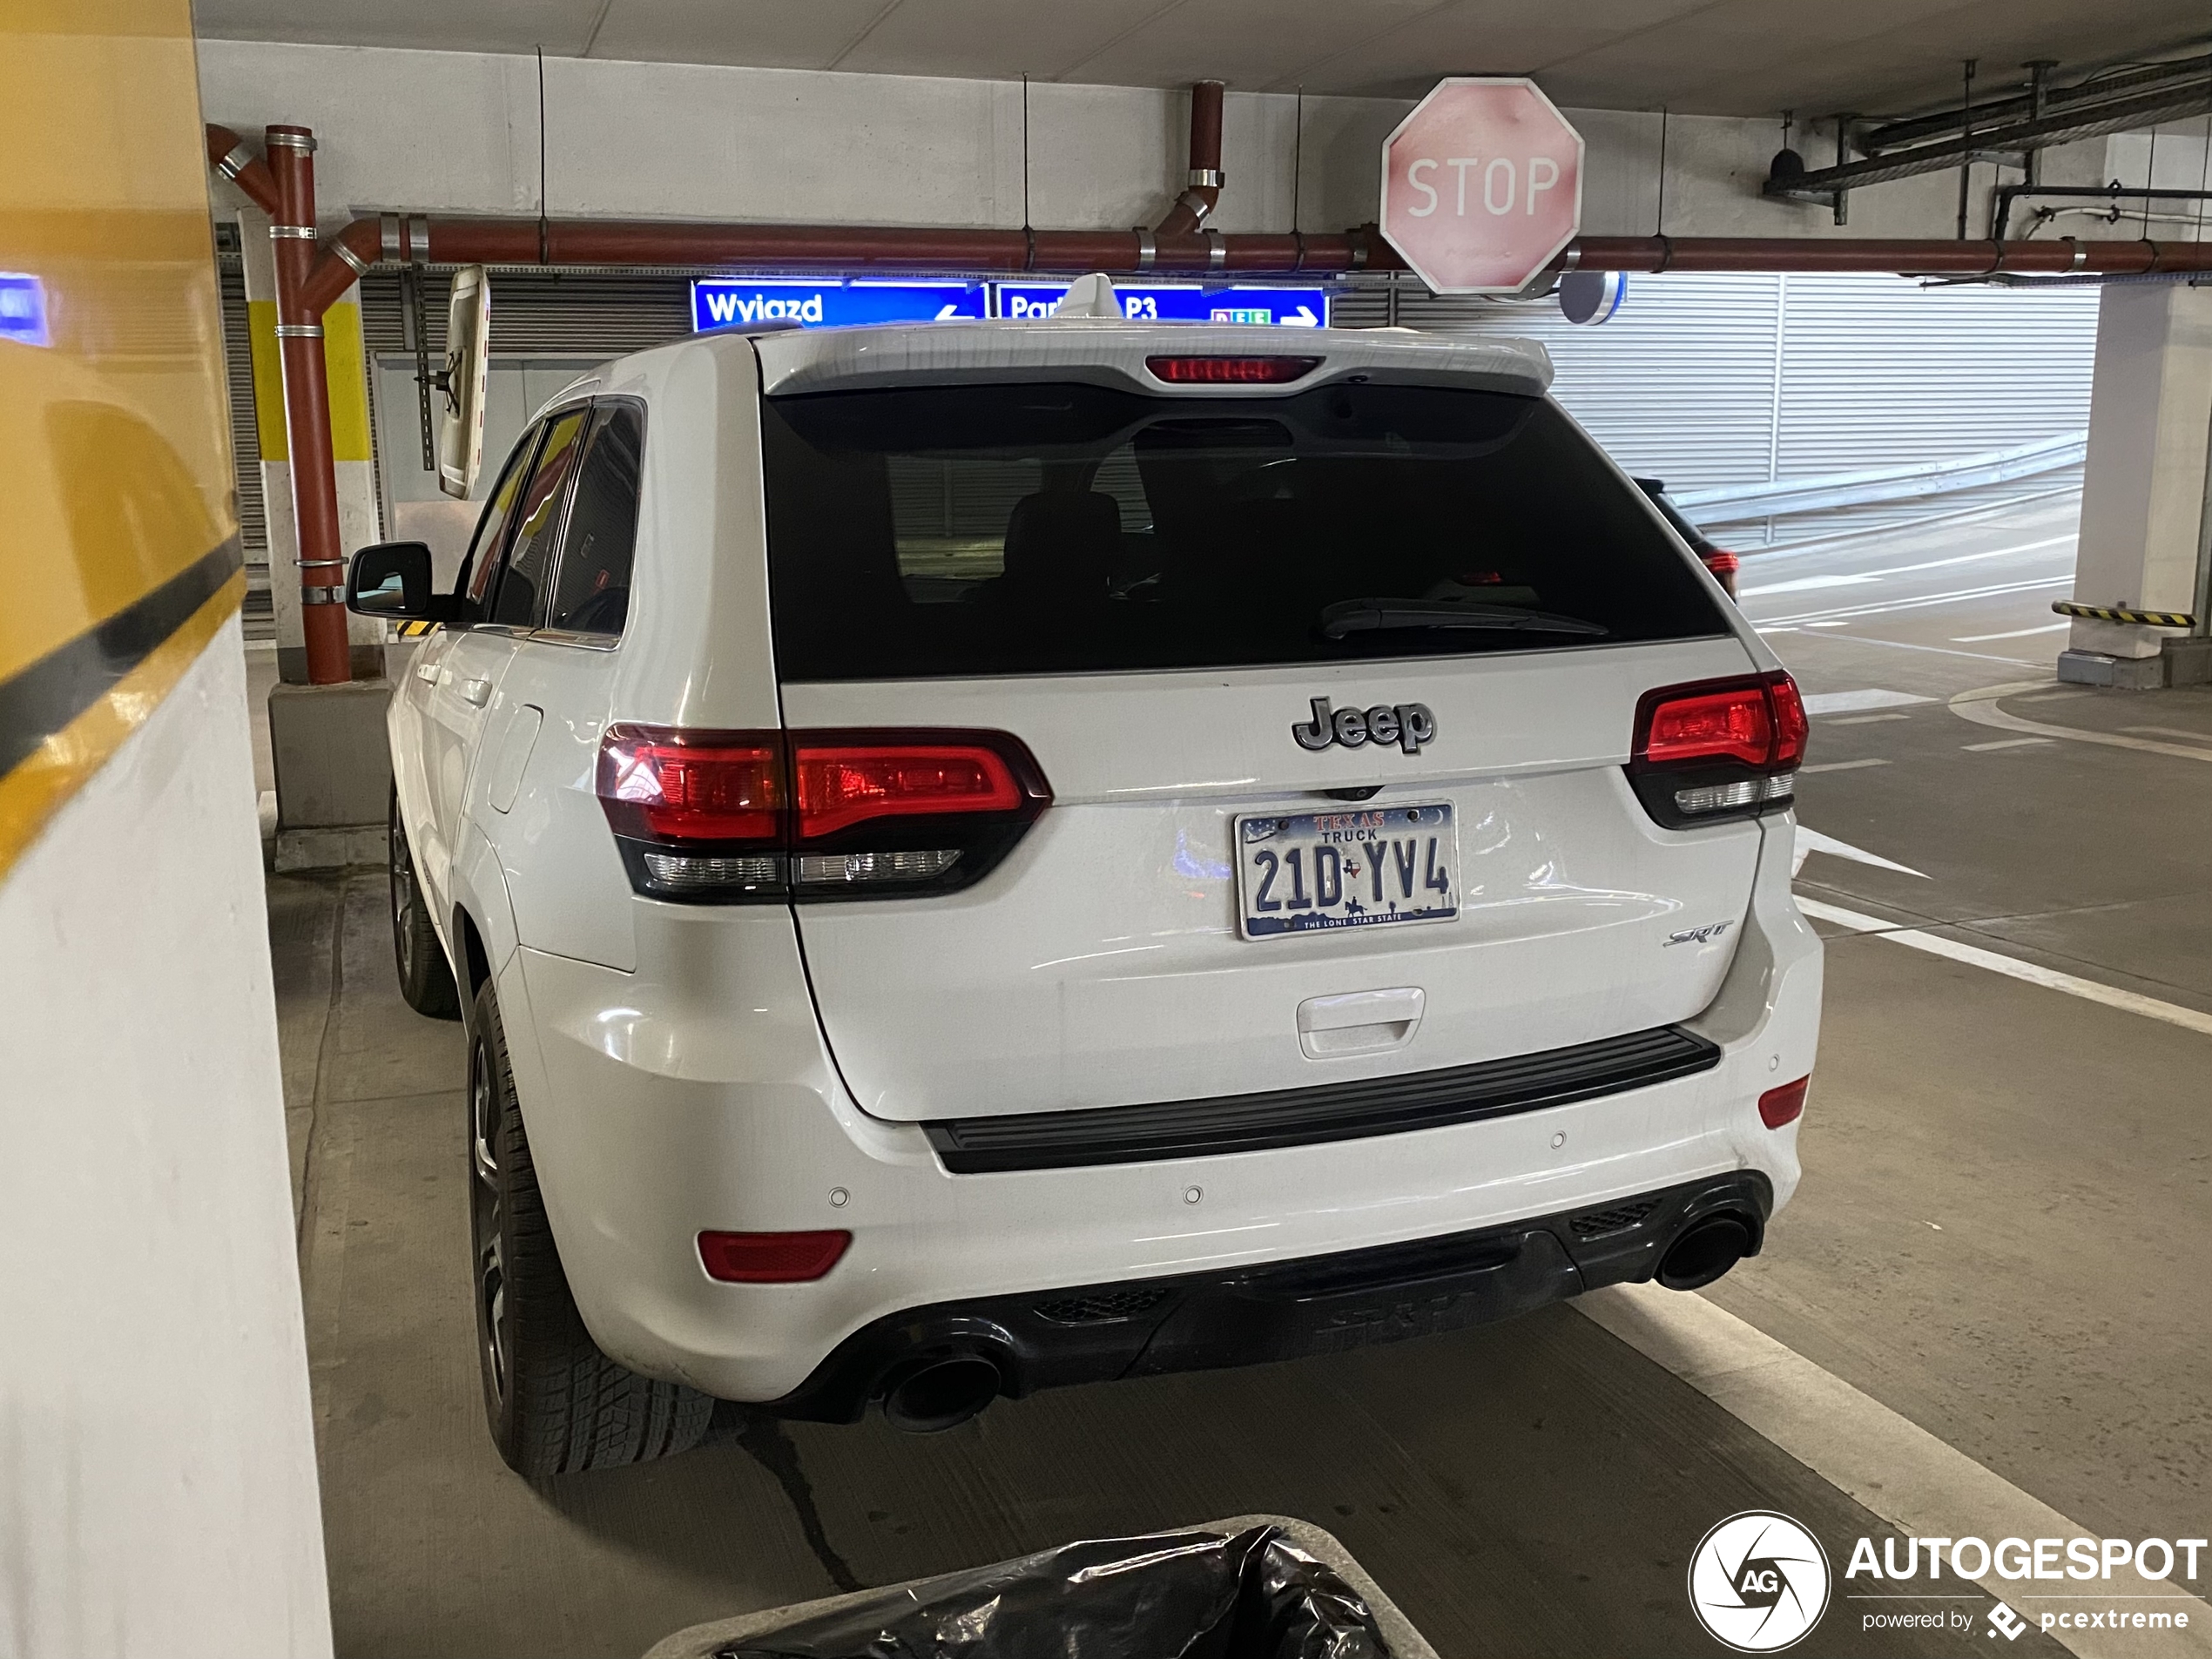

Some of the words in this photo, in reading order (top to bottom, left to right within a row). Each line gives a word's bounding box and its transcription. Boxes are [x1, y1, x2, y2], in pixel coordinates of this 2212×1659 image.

[1407, 157, 1560, 218] STOP
[1125, 296, 1158, 320] P3
[1291, 696, 1437, 755] Jeep
[1313, 811, 1386, 832] TEXAS
[1321, 828, 1379, 844] TRUCK
[1324, 919, 1347, 927] LONE
[1352, 916, 1374, 925] STAR
[1377, 913, 1402, 923] STATE
[1662, 920, 1734, 948] SRT
